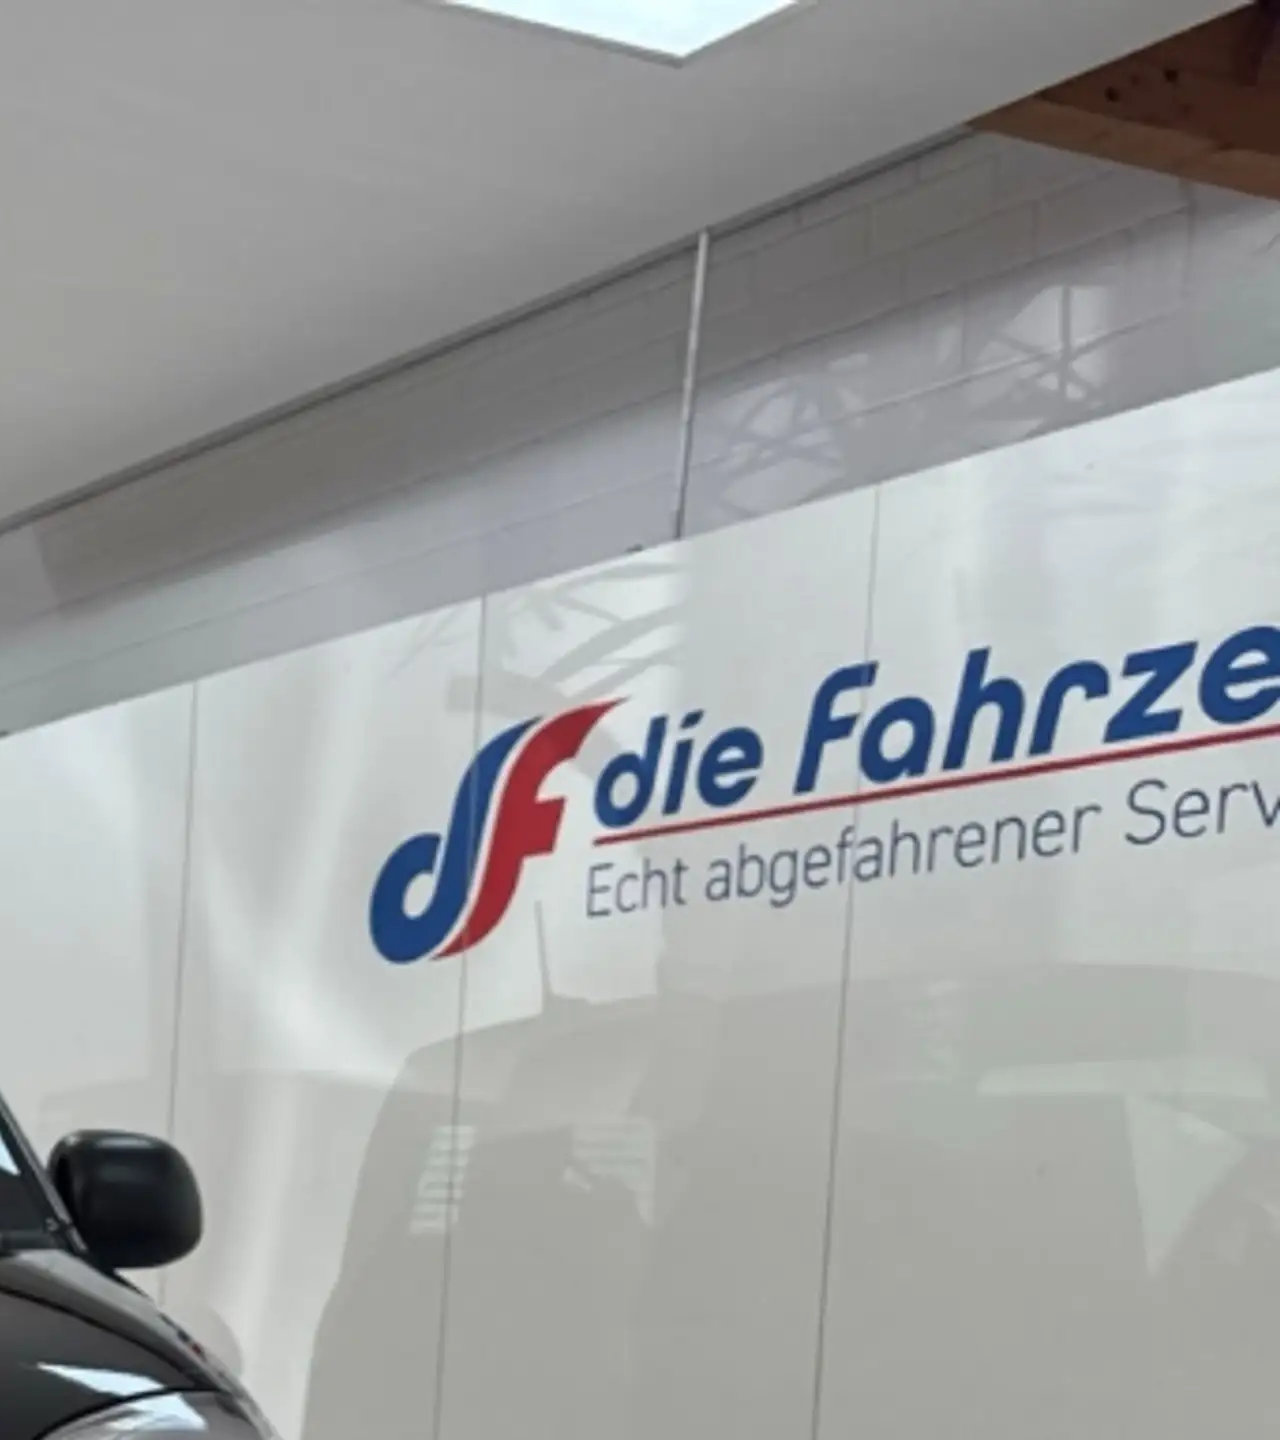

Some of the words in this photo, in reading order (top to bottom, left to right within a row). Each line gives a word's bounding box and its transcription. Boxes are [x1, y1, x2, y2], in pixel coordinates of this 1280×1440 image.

[593, 709, 765, 828] die
[586, 857, 690, 918] Echt
[704, 803, 1102, 908] abgefahrener
